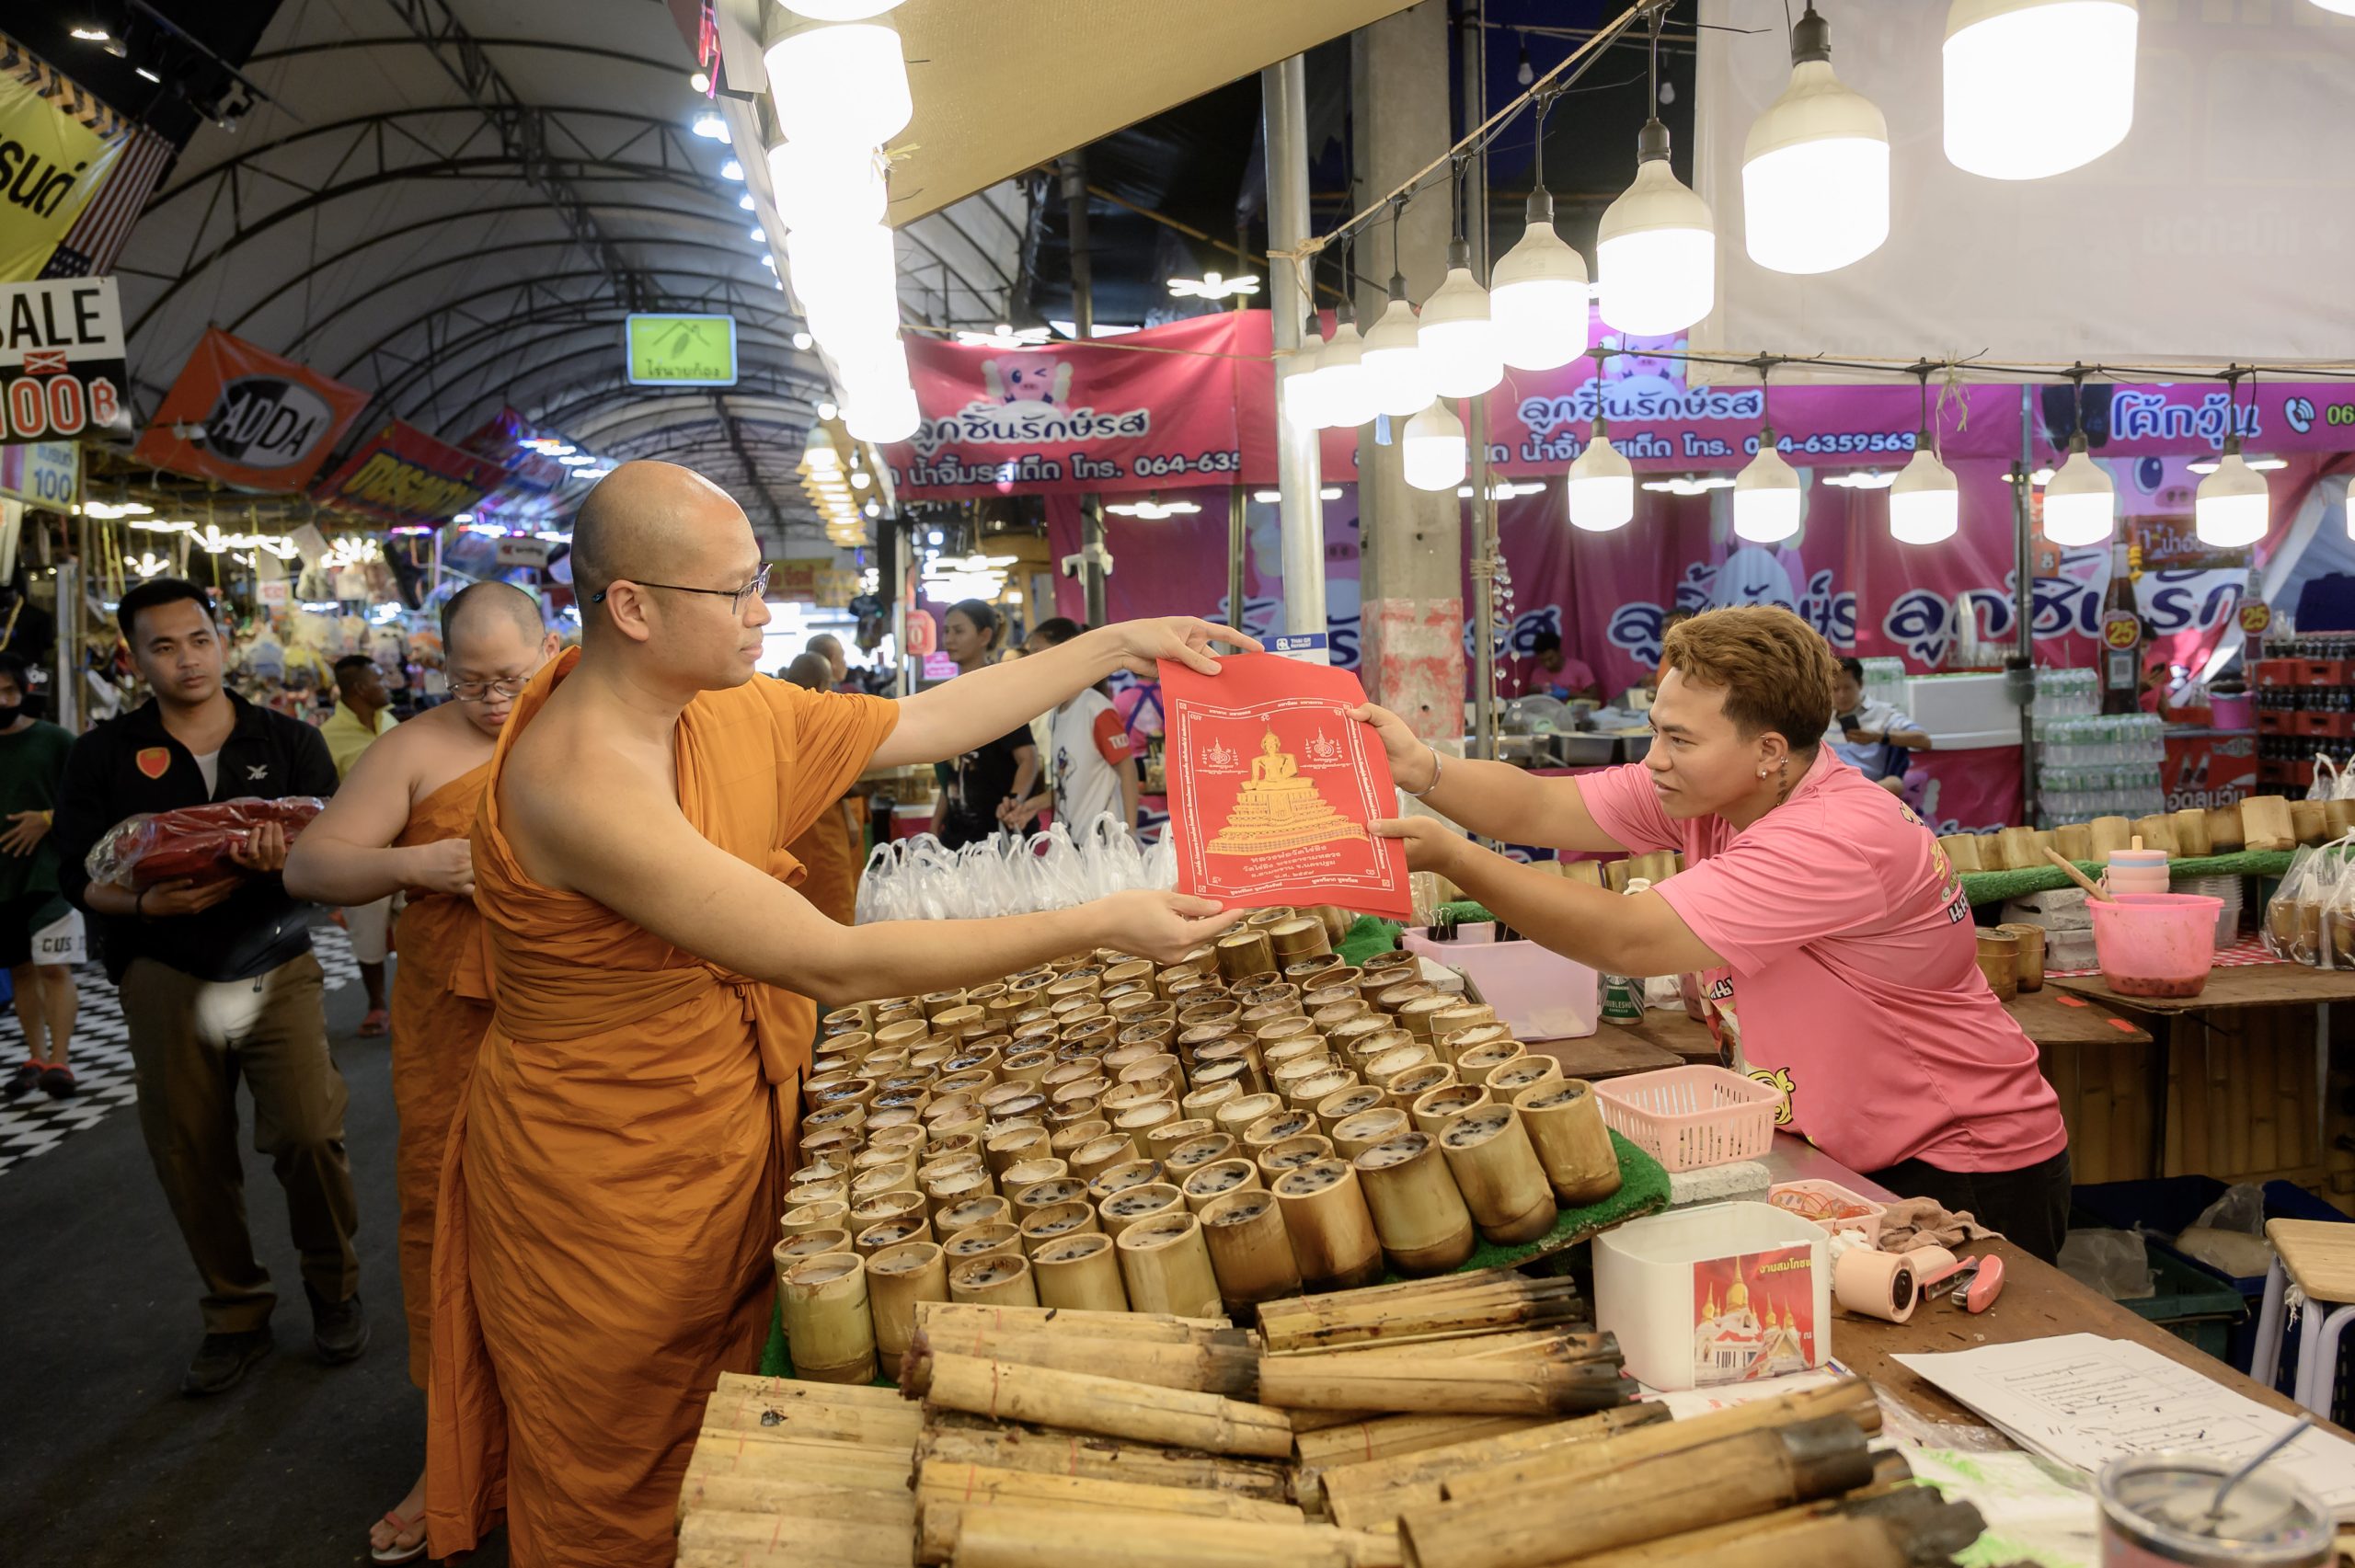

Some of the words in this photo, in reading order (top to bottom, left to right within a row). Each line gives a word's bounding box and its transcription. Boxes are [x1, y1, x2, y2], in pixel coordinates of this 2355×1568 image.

[0, 133, 87, 218] รนด์
[0, 289, 106, 349] ALE
[1521, 380, 1763, 432] ลูกชิ้นรักษ์รส
[2326, 404, 2355, 426] 06
[212, 392, 316, 457] ADDA
[1522, 432, 1671, 463] น้ำจิ้มสเด็ด
[1683, 432, 1732, 458] โทร.
[1744, 431, 1917, 455] 04-6359563
[34, 466, 72, 504] 100
[909, 453, 1061, 486] น้ำจิ้มรสเด็ด
[1074, 453, 1122, 479] โทร.
[2109, 620, 2134, 645] 25
[2243, 606, 2267, 631] 25
